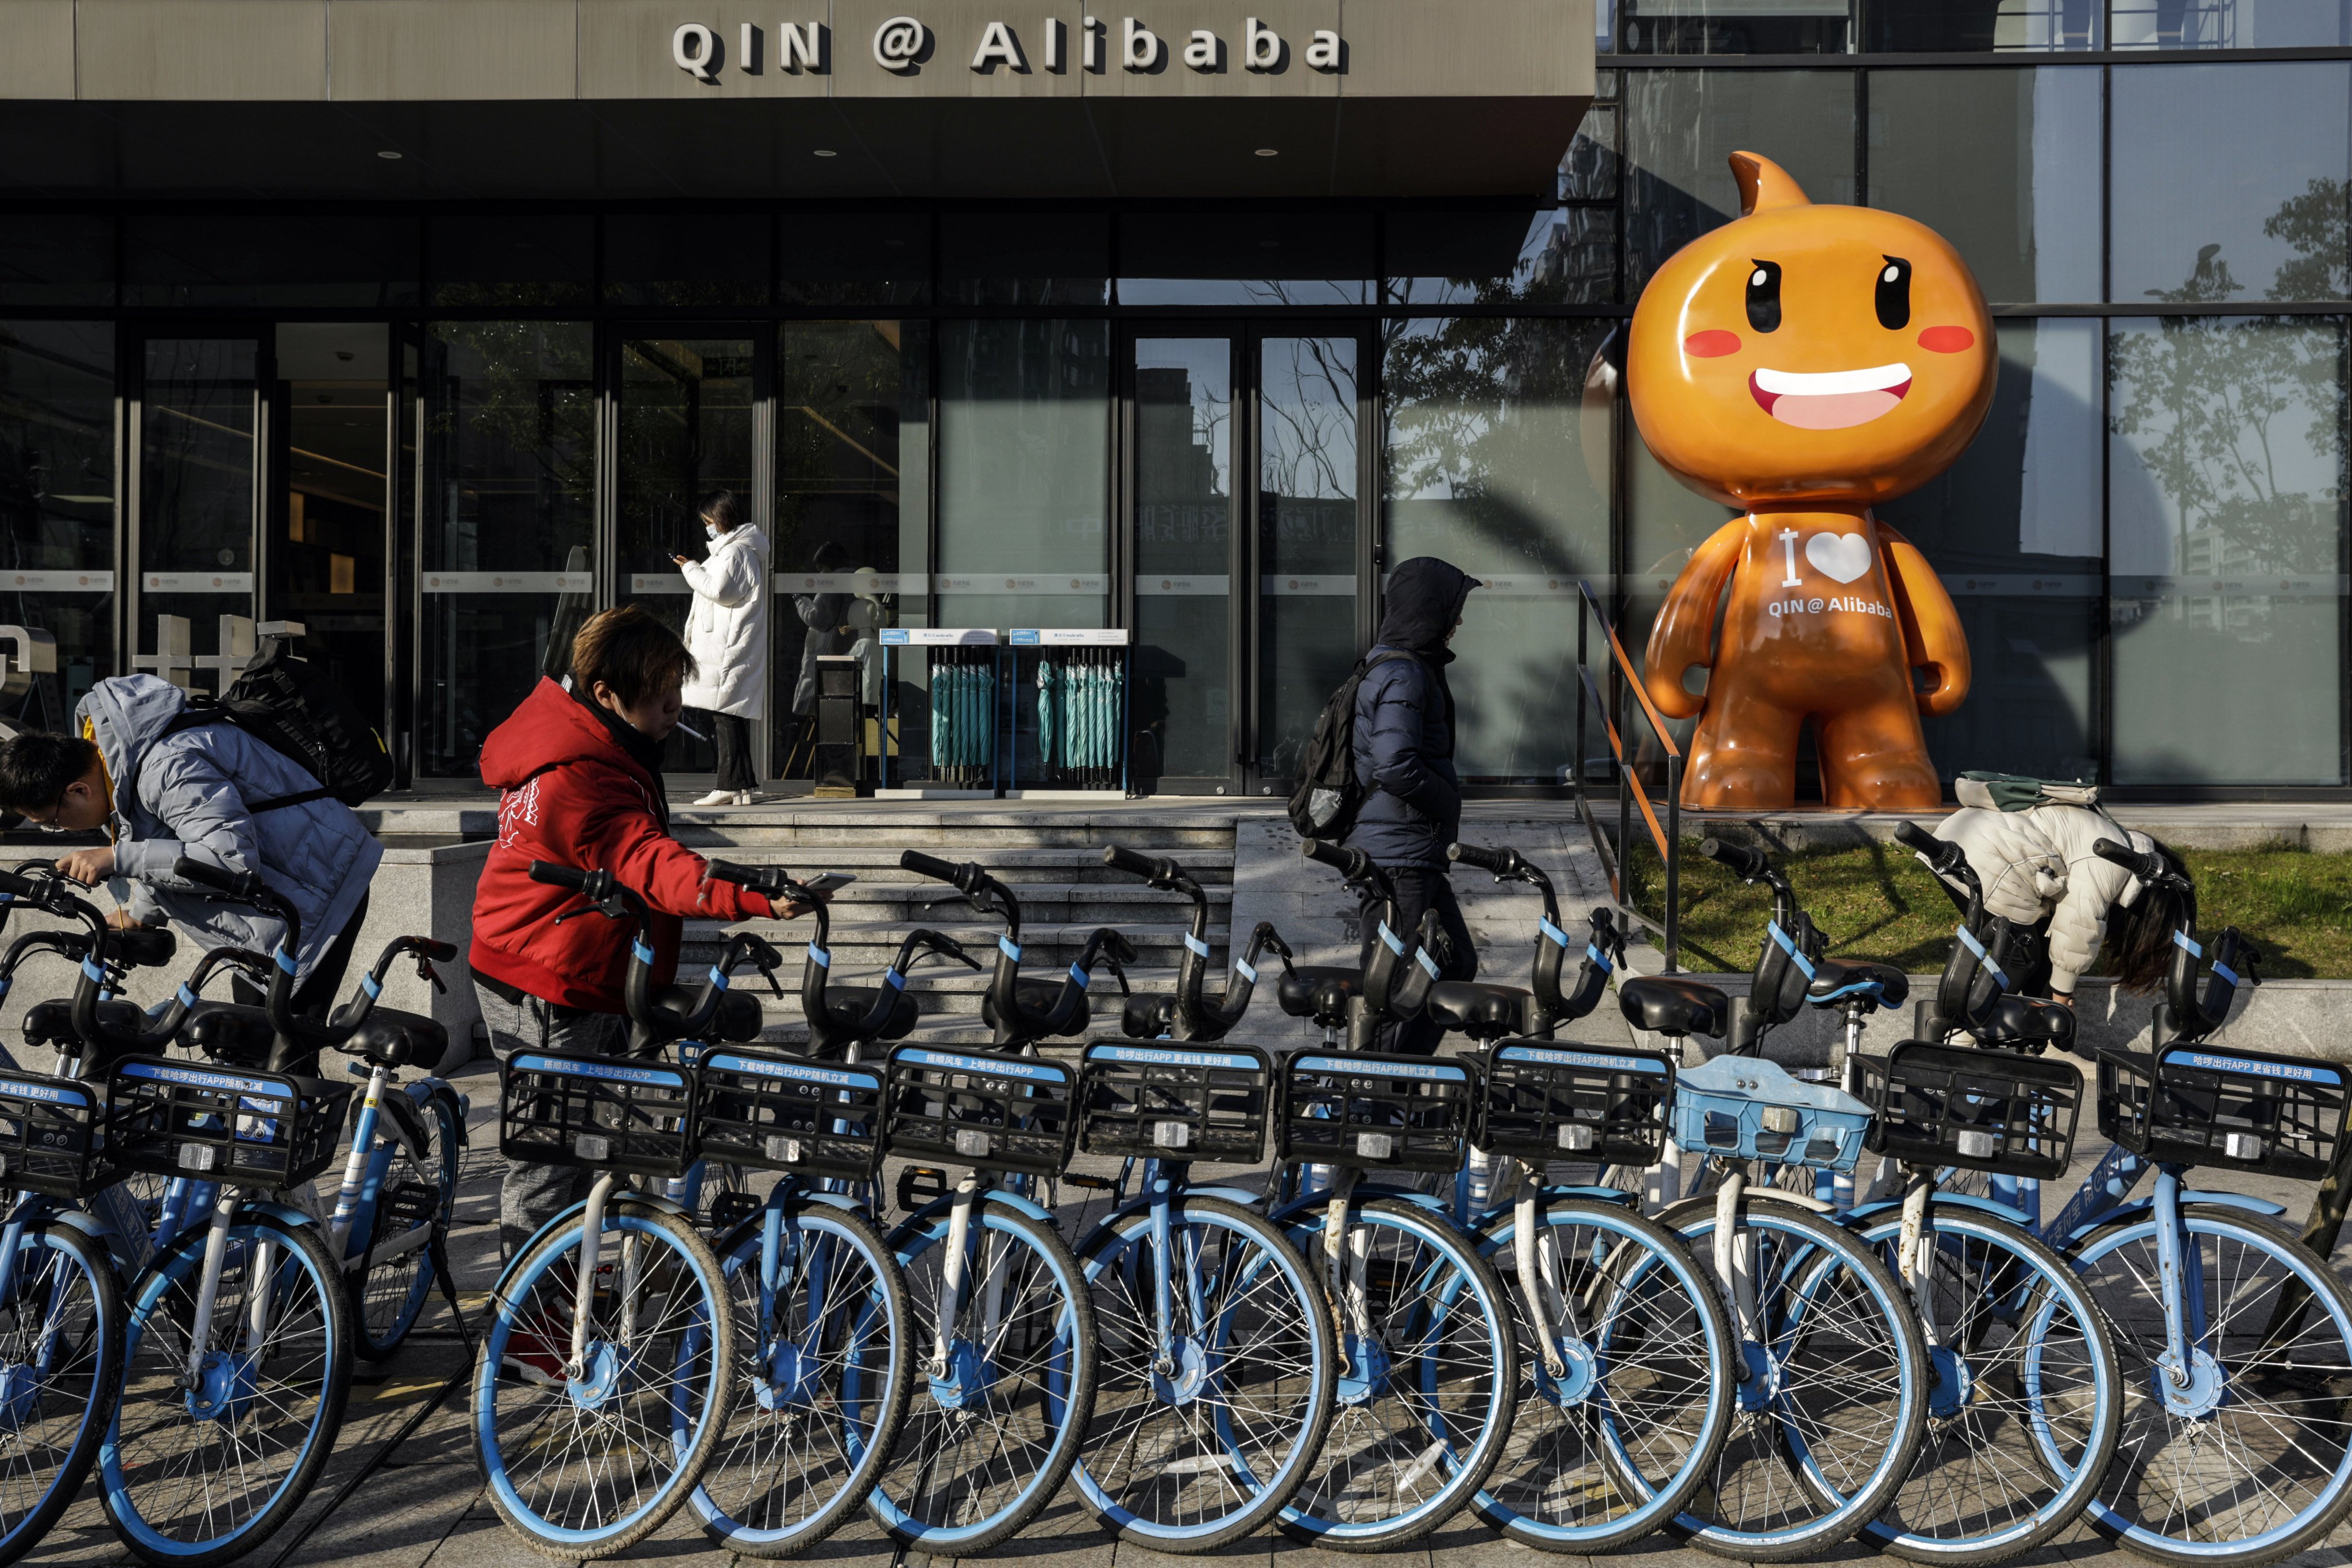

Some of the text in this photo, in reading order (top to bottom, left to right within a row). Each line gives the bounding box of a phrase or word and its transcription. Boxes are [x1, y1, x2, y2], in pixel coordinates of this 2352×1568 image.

[672, 15, 1341, 80] QIN @ Alibaba
[1779, 531, 1802, 588] I
[1768, 596, 1893, 619] QIN @ Alibaba
[2193, 1056, 2312, 1080] 哈啰出行APP 更省钱 更好用
[0, 1082, 59, 1100] 更省钱 更好用
